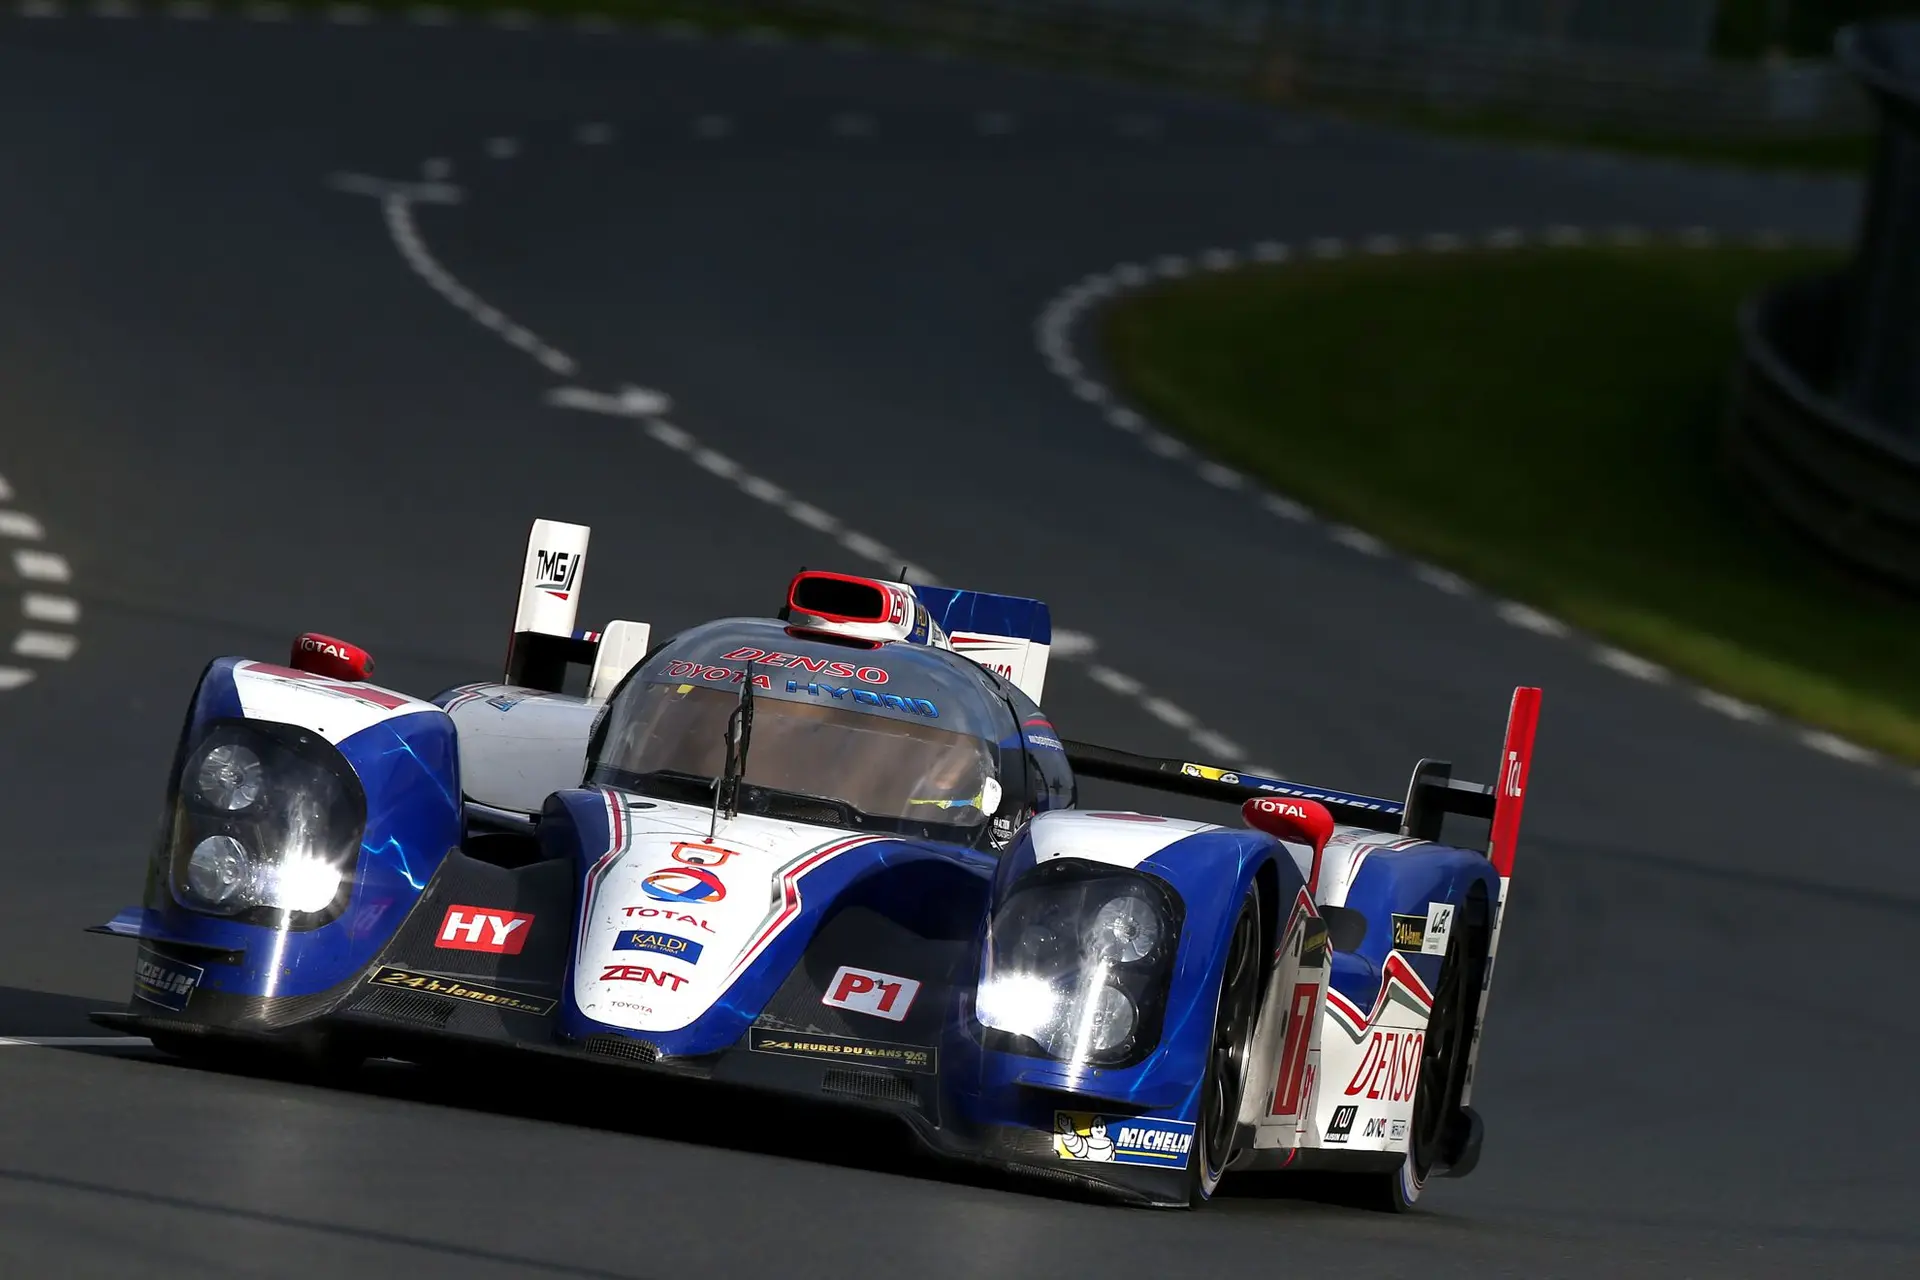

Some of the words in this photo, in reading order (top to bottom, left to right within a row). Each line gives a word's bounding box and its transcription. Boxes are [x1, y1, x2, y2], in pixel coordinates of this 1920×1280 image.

[536, 549, 569, 582] TMG
[300, 637, 350, 660] TOTAL
[720, 646, 890, 685] DENSO
[658, 659, 772, 690] TOYOTA
[785, 679, 940, 719] HYBRID
[1252, 798, 1308, 819] TOTAL
[441, 911, 527, 946] HY
[621, 906, 716, 934] TOTAL
[631, 933, 688, 952] KALDI
[599, 965, 690, 992] ZENT
[832, 972, 902, 1013] P1
[611, 1001, 653, 1014] TOYOTA
[758, 1039, 792, 1050] 24
[793, 1042, 842, 1054] HEURES
[843, 1046, 864, 1055] DU
[865, 1047, 903, 1058] MANS
[1344, 1032, 1424, 1103] DENSO
[1116, 1127, 1193, 1154] MICHELIN
